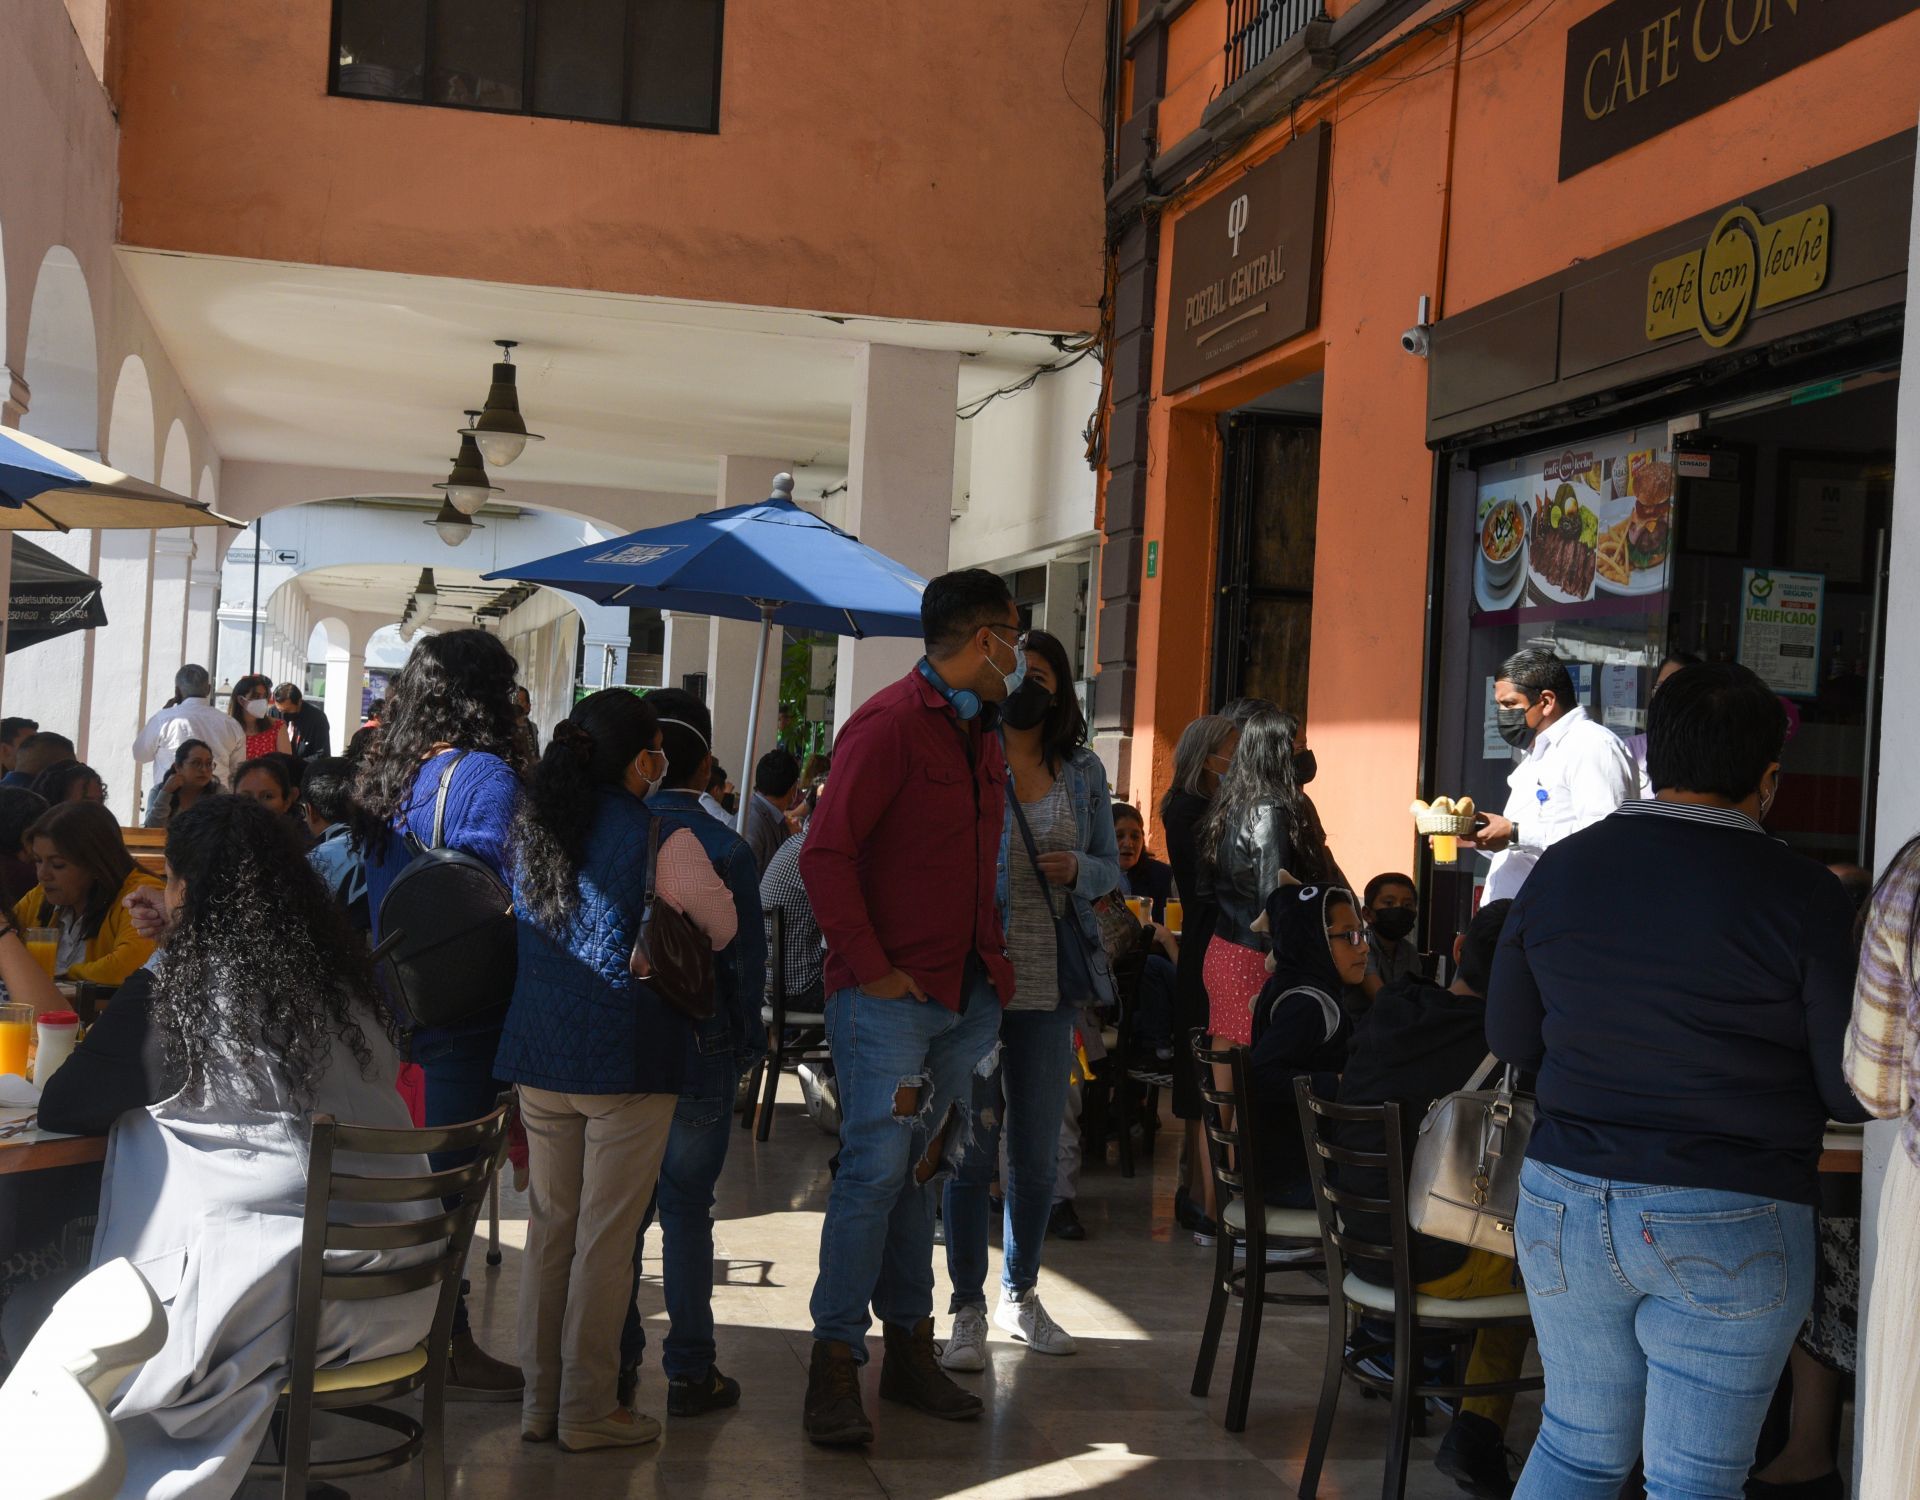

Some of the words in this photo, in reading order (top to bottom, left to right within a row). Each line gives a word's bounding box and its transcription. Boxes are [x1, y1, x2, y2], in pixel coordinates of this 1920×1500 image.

[1583, 8, 1682, 121] CAFE
[1184, 278, 1228, 332] PORTAL
[1228, 244, 1286, 307] CENTRAL
[1652, 262, 1696, 320] café
[1709, 262, 1748, 295] con
[1764, 217, 1823, 279] leche
[1746, 608, 1817, 625] VERIFICADO
